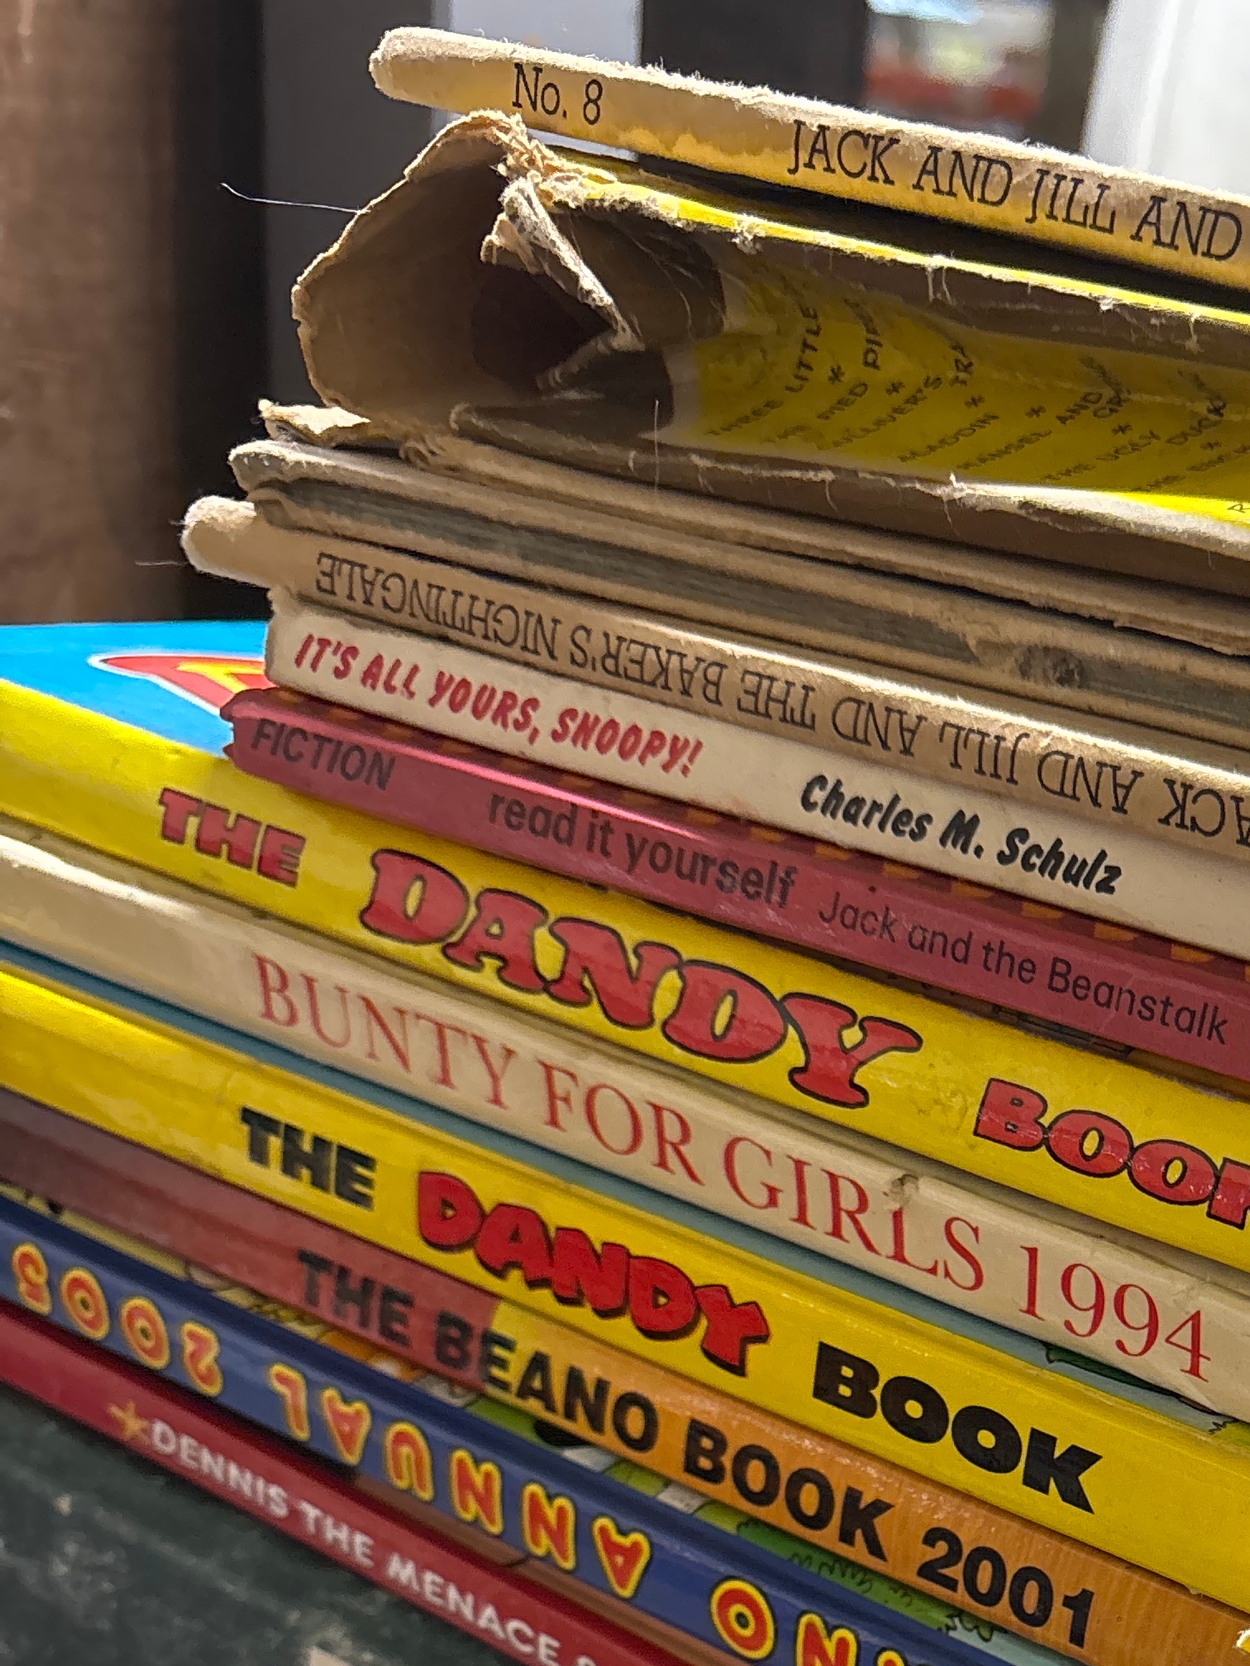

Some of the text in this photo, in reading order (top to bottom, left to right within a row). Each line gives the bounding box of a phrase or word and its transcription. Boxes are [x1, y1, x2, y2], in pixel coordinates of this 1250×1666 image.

[511, 61, 569, 118] No.
[582, 78, 604, 125] 8
[788, 119, 900, 186] JACK
[912, 146, 1013, 207] AND
[1025, 166, 1116, 234] JILL
[1130, 195, 1242, 262] AND
[316, 551, 557, 669] NIGHTINGALE
[569, 627, 728, 704] BAKER'S
[294, 632, 703, 778] IT'S ALL YOURS, SNOOPY!
[737, 670, 817, 731] THE
[832, 697, 928, 756] AND
[938, 722, 1024, 786] JILL
[800, 774, 1123, 896] Charles M. Schulz
[1038, 749, 1140, 815] AND
[158, 787, 307, 888] THE
[358, 847, 923, 1108] DANDY
[251, 717, 395, 791] FICTION
[488, 791, 575, 847] read
[586, 809, 615, 860] it
[626, 828, 799, 909] yourself
[819, 890, 898, 944] Jack
[907, 924, 970, 965] and
[981, 939, 1037, 986] the
[1048, 957, 1230, 1047] Beanstalk
[253, 953, 1212, 1383] BUNTY FOR GIRLS 1994
[12, 1243, 224, 1397] 2005
[240, 1106, 1103, 1514] THE DANDY BOOK
[149, 1417, 290, 1518] DENNIS
[300, 1500, 375, 1564] THE
[268, 1361, 651, 1599] ANNUAL
[299, 1250, 1096, 1649] THE BEANO BOOK 2001
